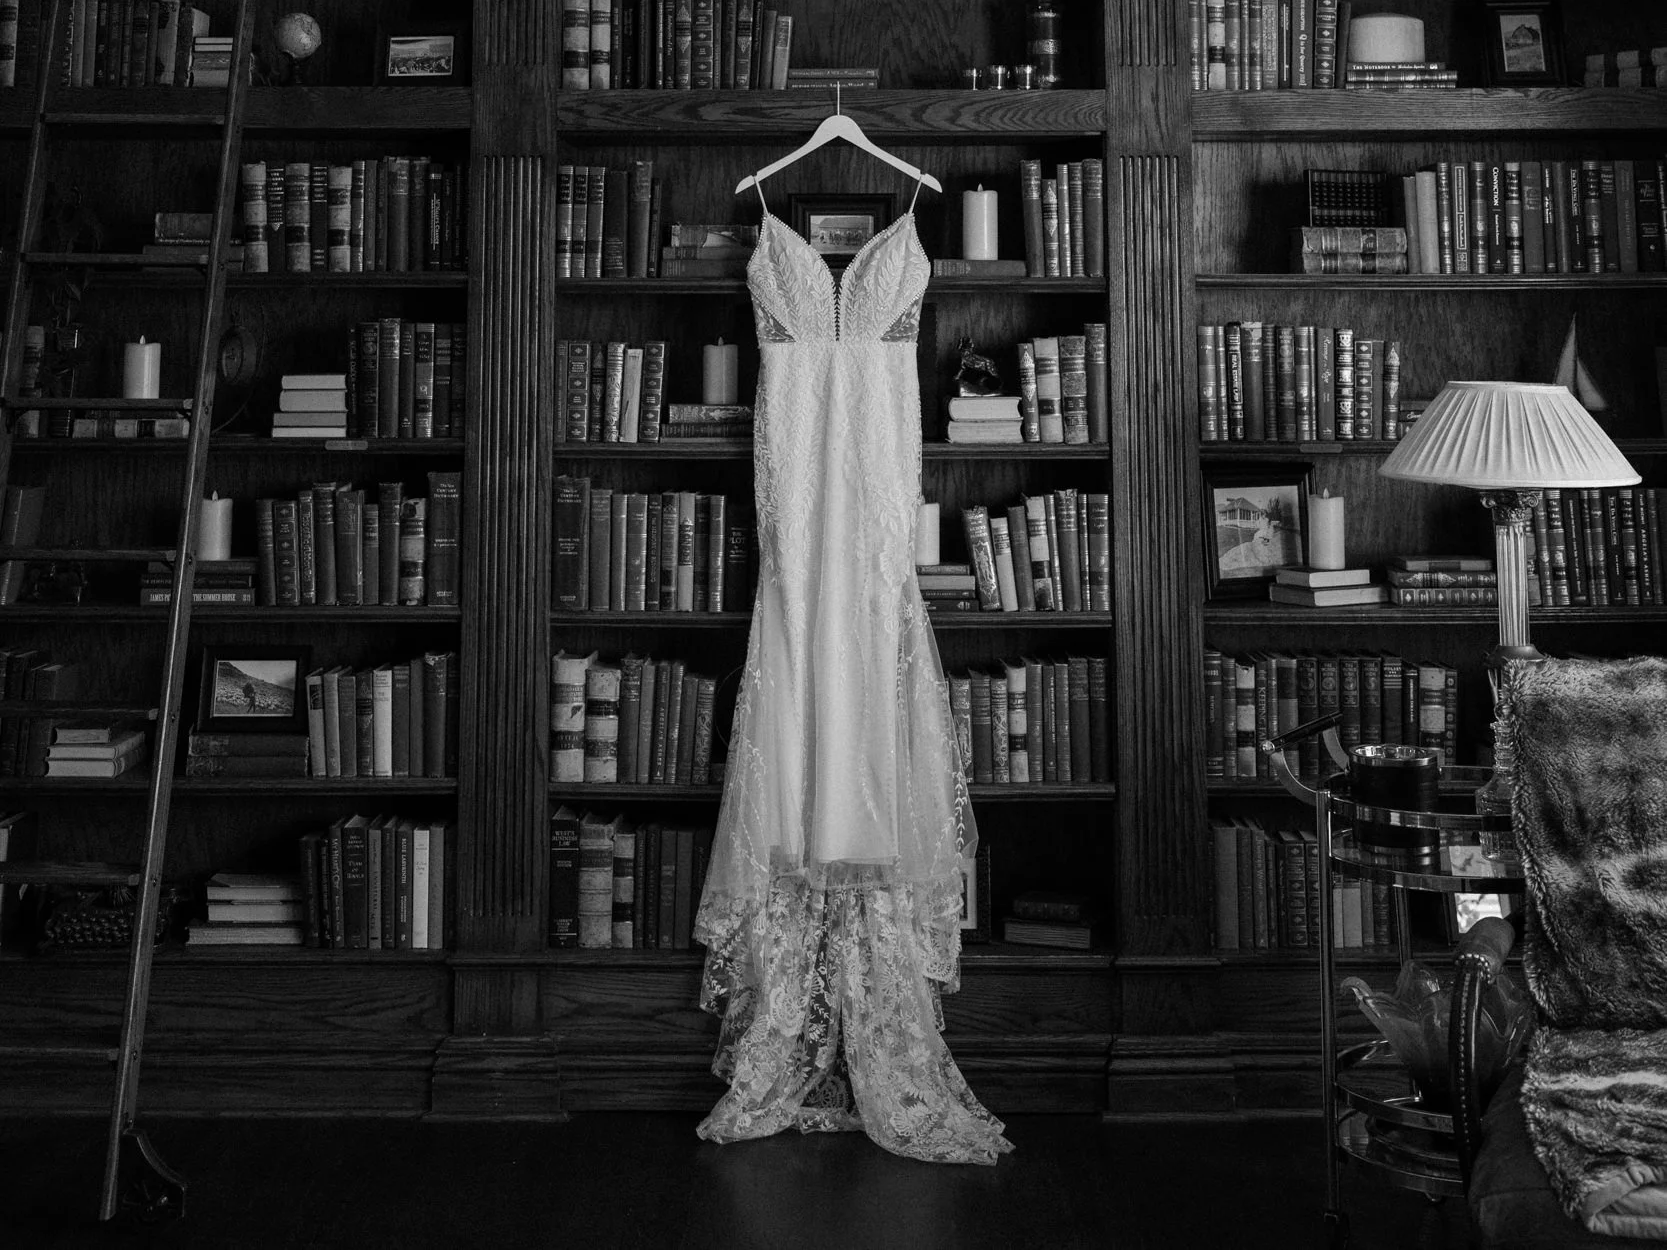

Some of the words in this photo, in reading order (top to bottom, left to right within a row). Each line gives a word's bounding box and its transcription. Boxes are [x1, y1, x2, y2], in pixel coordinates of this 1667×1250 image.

[149, 594, 164, 602] JAMES
[192, 593, 202, 602] THE
[202, 593, 222, 602] SUMMER
[222, 593, 236, 602] HOUSE
[1258, 686, 1266, 724] KEEPING
